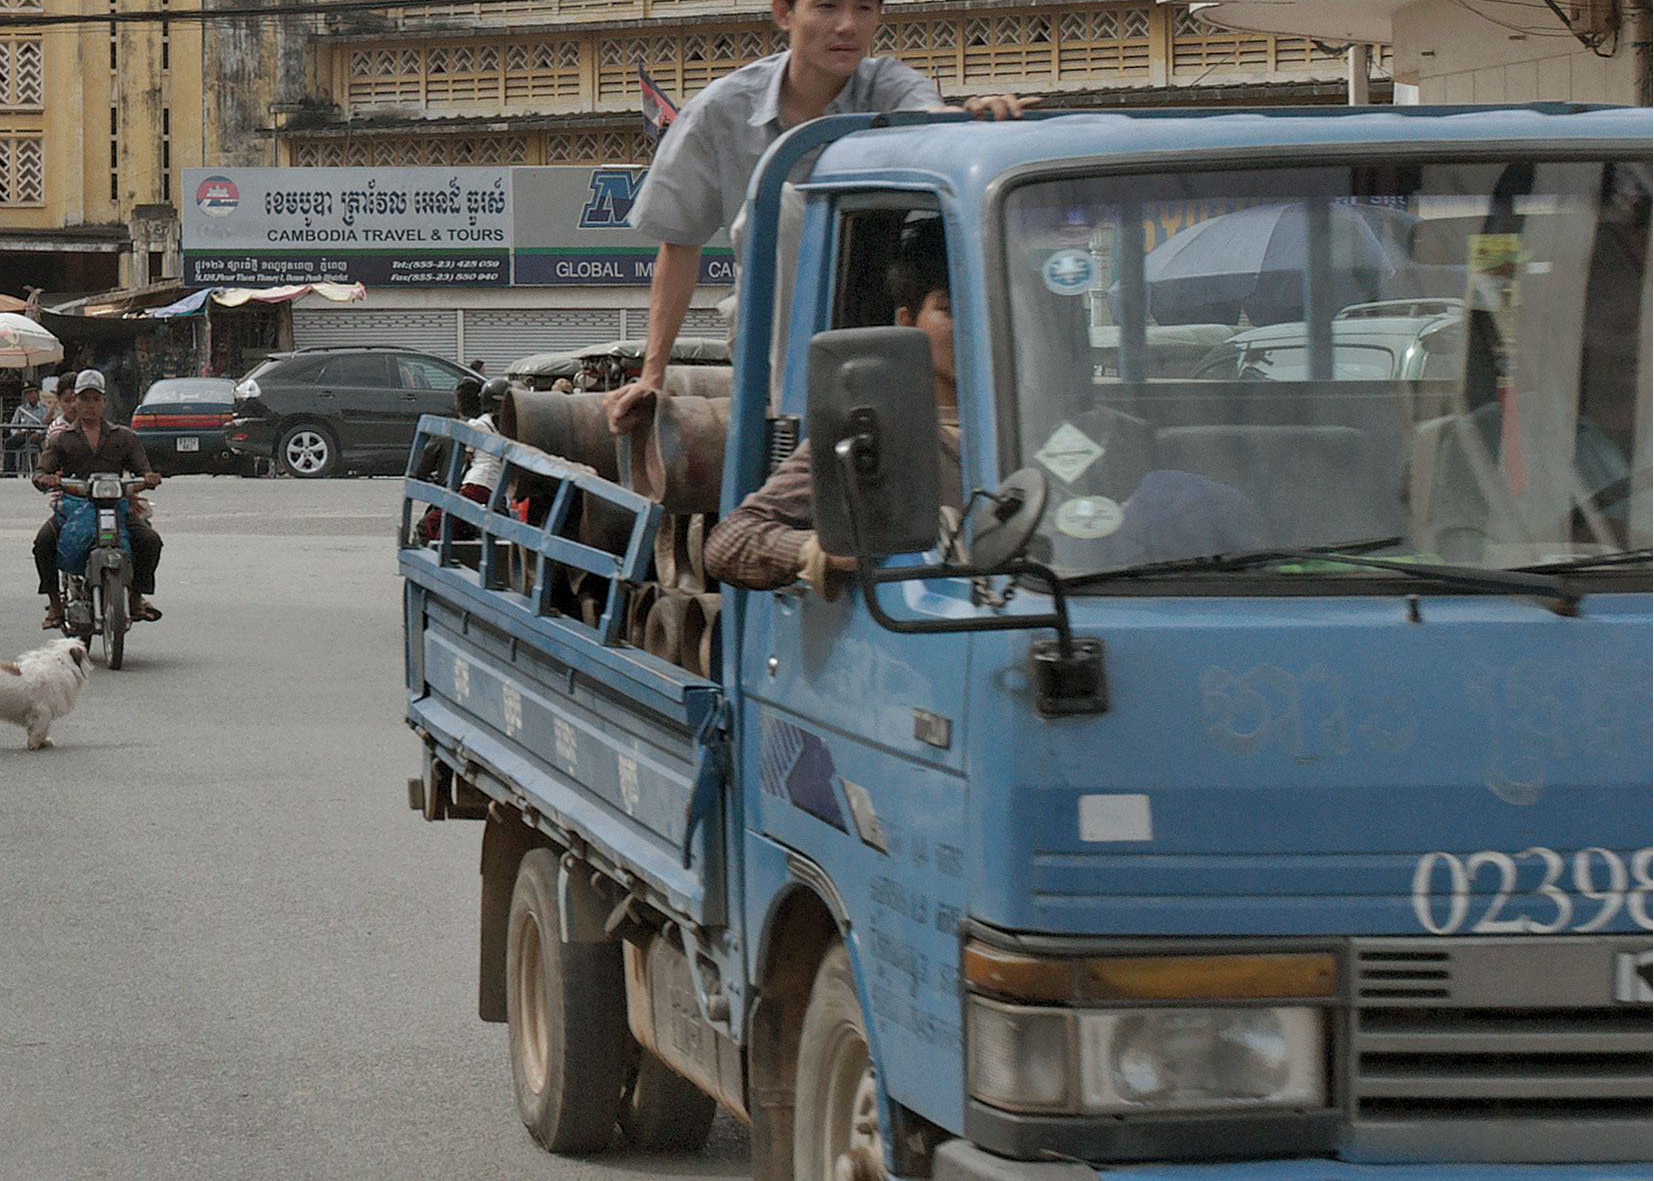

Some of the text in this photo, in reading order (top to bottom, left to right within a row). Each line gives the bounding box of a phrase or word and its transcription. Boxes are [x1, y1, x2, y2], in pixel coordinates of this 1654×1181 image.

[267, 229, 505, 242] CAMBODIA TRAVEL & TOURS
[555, 261, 624, 278] GLOBAL
